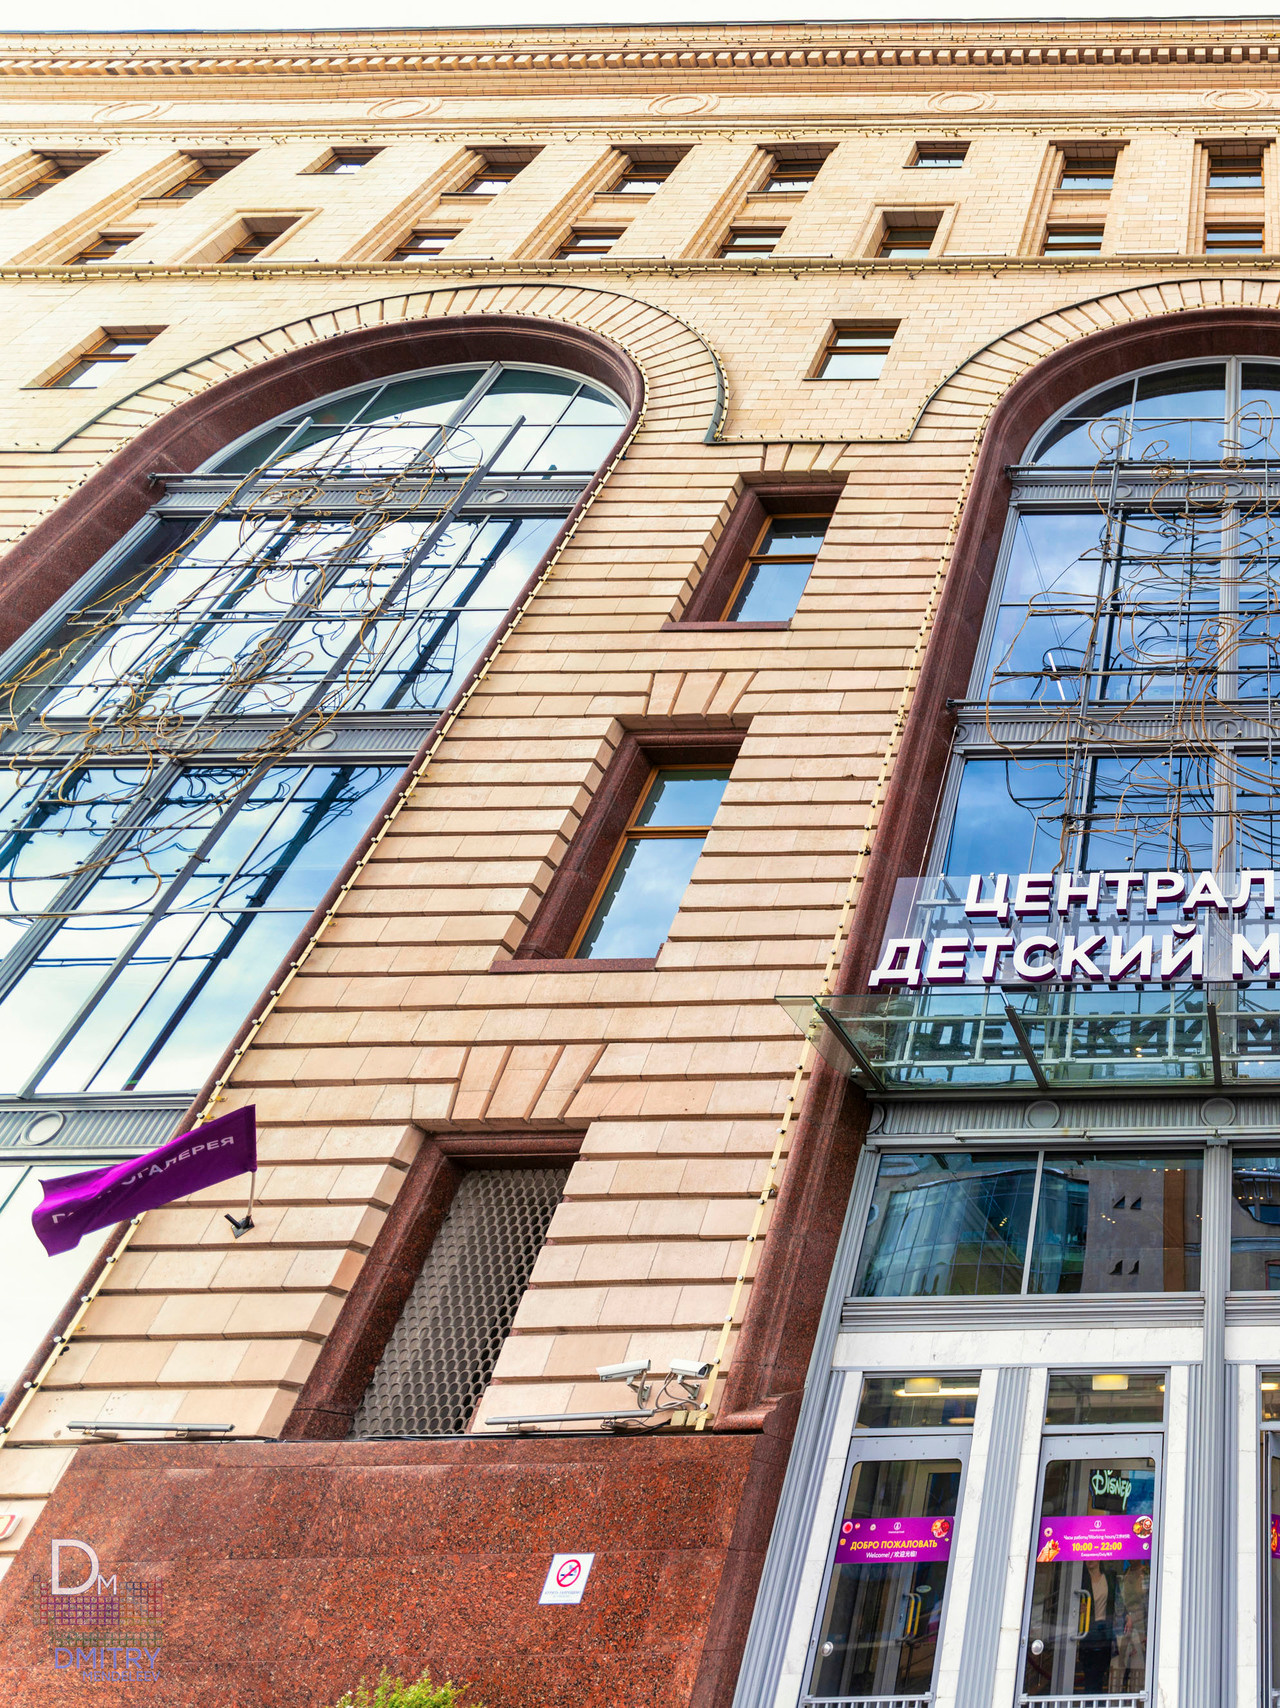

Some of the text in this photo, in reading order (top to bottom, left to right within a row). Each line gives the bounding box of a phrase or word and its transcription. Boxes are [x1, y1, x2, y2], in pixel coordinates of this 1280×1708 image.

[868, 924, 1203, 989] ДЕТСКИЙ
[850, 1539, 938, 1551] ДОБРО ПОЖАЛОВАТЬ
[1072, 1543, 1093, 1551] 10:00
[1100, 1542, 1122, 1551] 22:00
